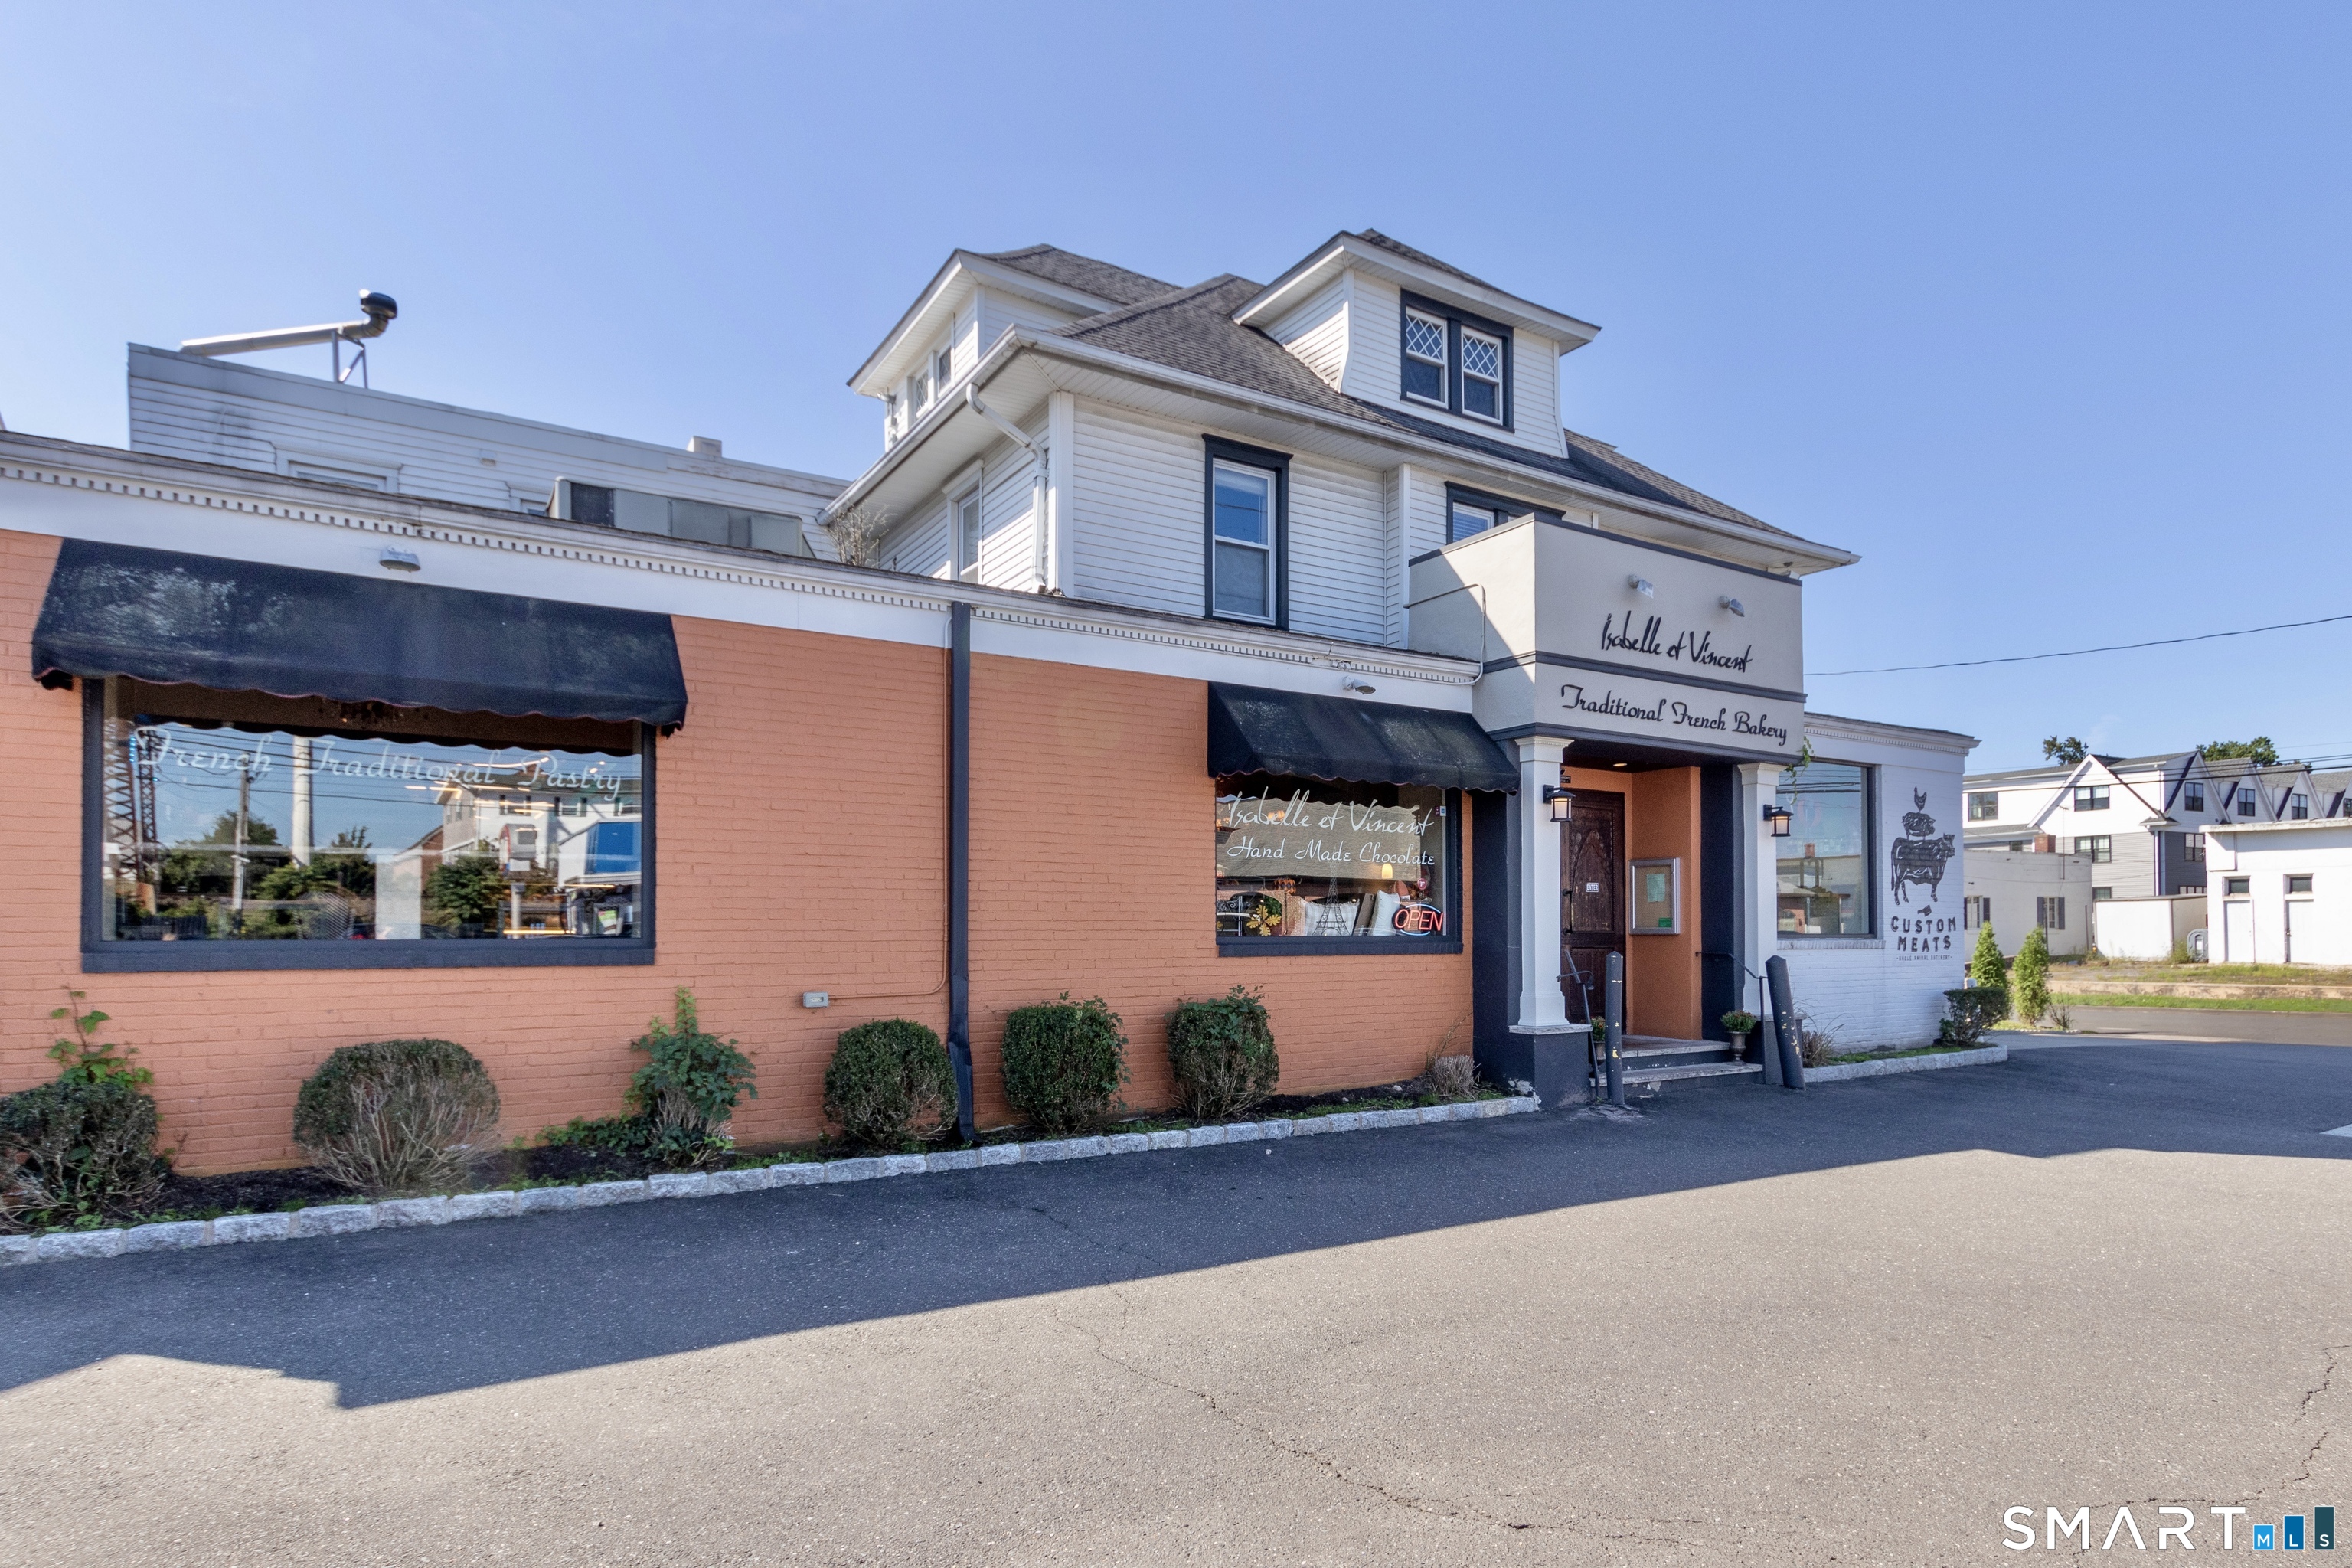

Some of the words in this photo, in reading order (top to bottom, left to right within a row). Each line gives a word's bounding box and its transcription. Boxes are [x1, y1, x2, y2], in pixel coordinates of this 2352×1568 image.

[1602, 611, 1662, 655] Isabelle
[1667, 631, 1687, 660] et
[1690, 631, 1753, 673] Vincent
[1561, 684, 1667, 722] Traditional
[1672, 701, 1726, 731] French
[1732, 711, 1787, 746] Bakery
[134, 726, 273, 772] French
[299, 736, 501, 784] Traditional
[518, 751, 621, 801] Pastry
[1228, 786, 1309, 828] Isabelle
[1318, 801, 1345, 830] et
[1349, 799, 1435, 836] Vincent
[1227, 836, 1286, 859] Hand
[1295, 839, 1351, 861] Made
[1359, 842, 1435, 865] Chocolate
[1394, 909, 1444, 931] OPEN
[1890, 916, 1956, 934] CUSTOM
[1897, 935, 1951, 952] MEATS
